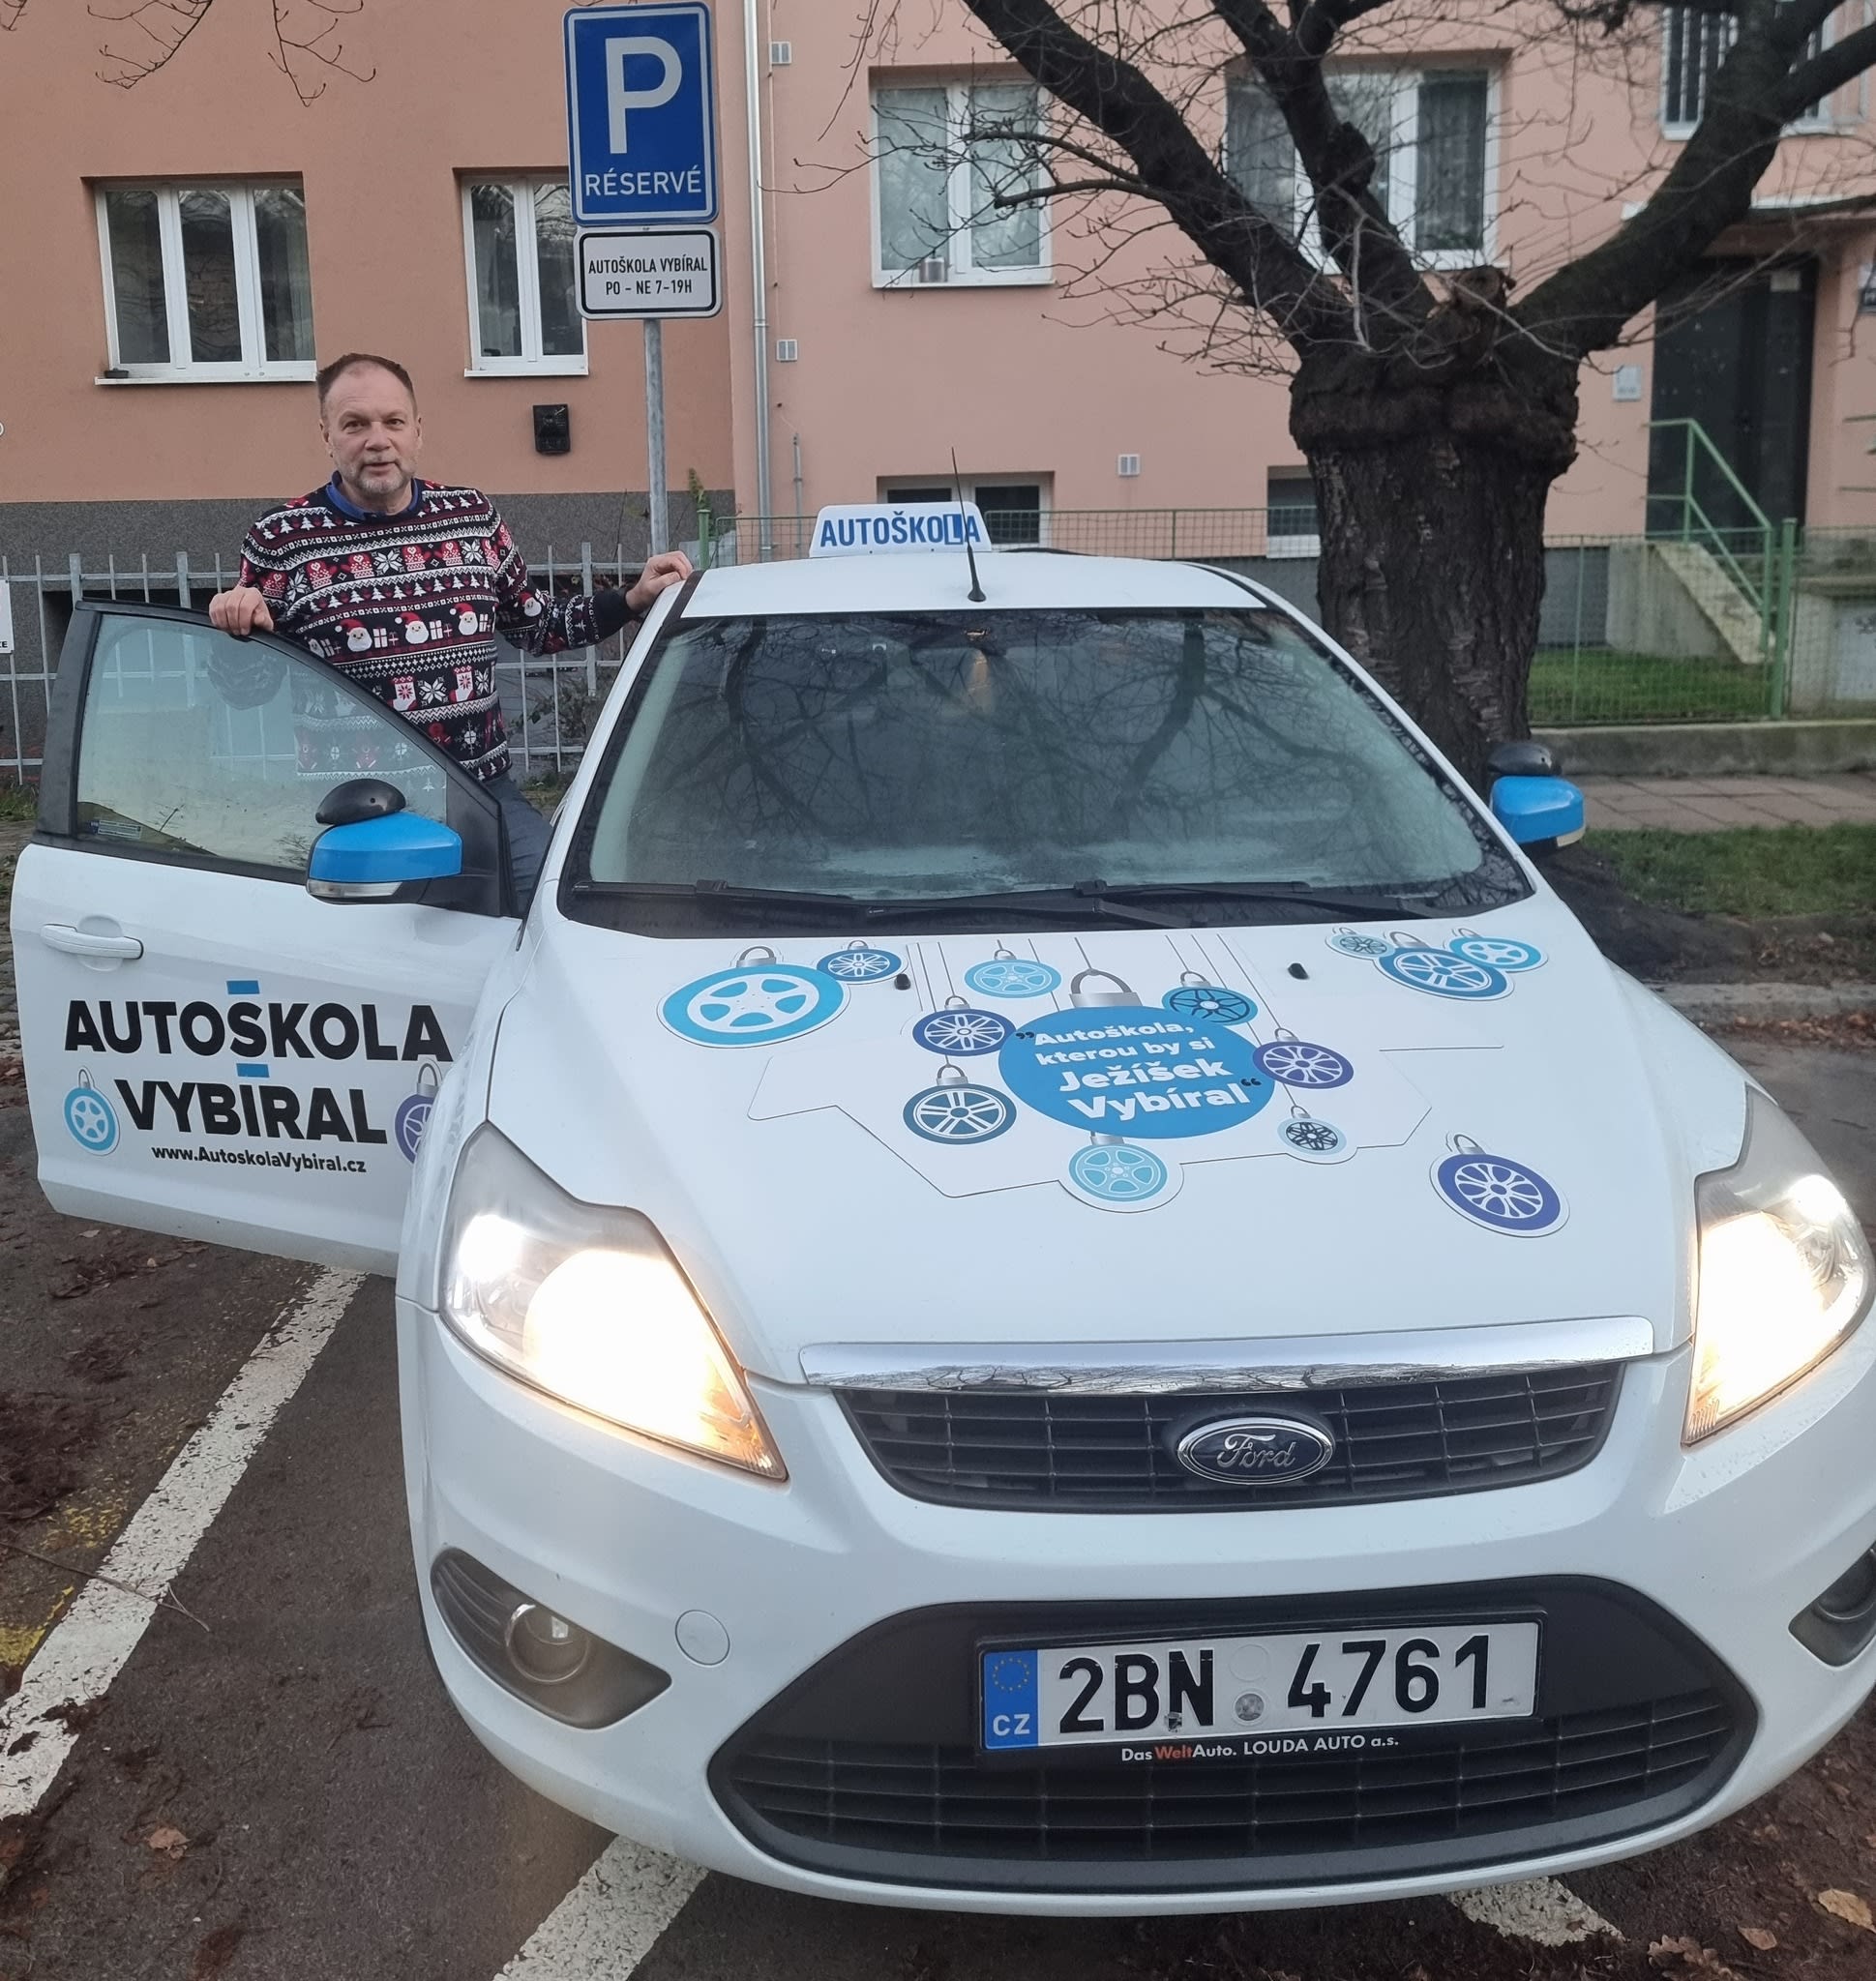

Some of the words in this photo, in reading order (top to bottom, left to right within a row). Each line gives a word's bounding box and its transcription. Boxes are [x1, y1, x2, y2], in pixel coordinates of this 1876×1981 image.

[605, 36, 682, 155] P
[585, 164, 701, 196] RÉSERVÉ
[588, 256, 657, 274] AUTOŠKOLA
[659, 253, 707, 272] VYBÍRAL
[606, 281, 620, 295] PO
[636, 280, 651, 295] NE
[820, 511, 981, 547] AUTOŠKOLA
[1034, 1046, 1138, 1066] kterou
[1143, 1041, 1180, 1055] by
[1188, 1036, 1215, 1050] si
[1059, 1057, 1234, 1092] Ježíšek
[151, 1146, 367, 1173] www.AutoskolaVybiral.cz
[1216, 1433, 1297, 1468] Ford
[1058, 1649, 1215, 1734] 2BN
[1287, 1634, 1490, 1719] 4761
[993, 1713, 1030, 1737] CZ
[1121, 1748, 1153, 1761] Das
[1243, 1738, 1309, 1756] LOUDA
[1314, 1734, 1366, 1752] AUTO
[1370, 1735, 1399, 1747] a.s.
